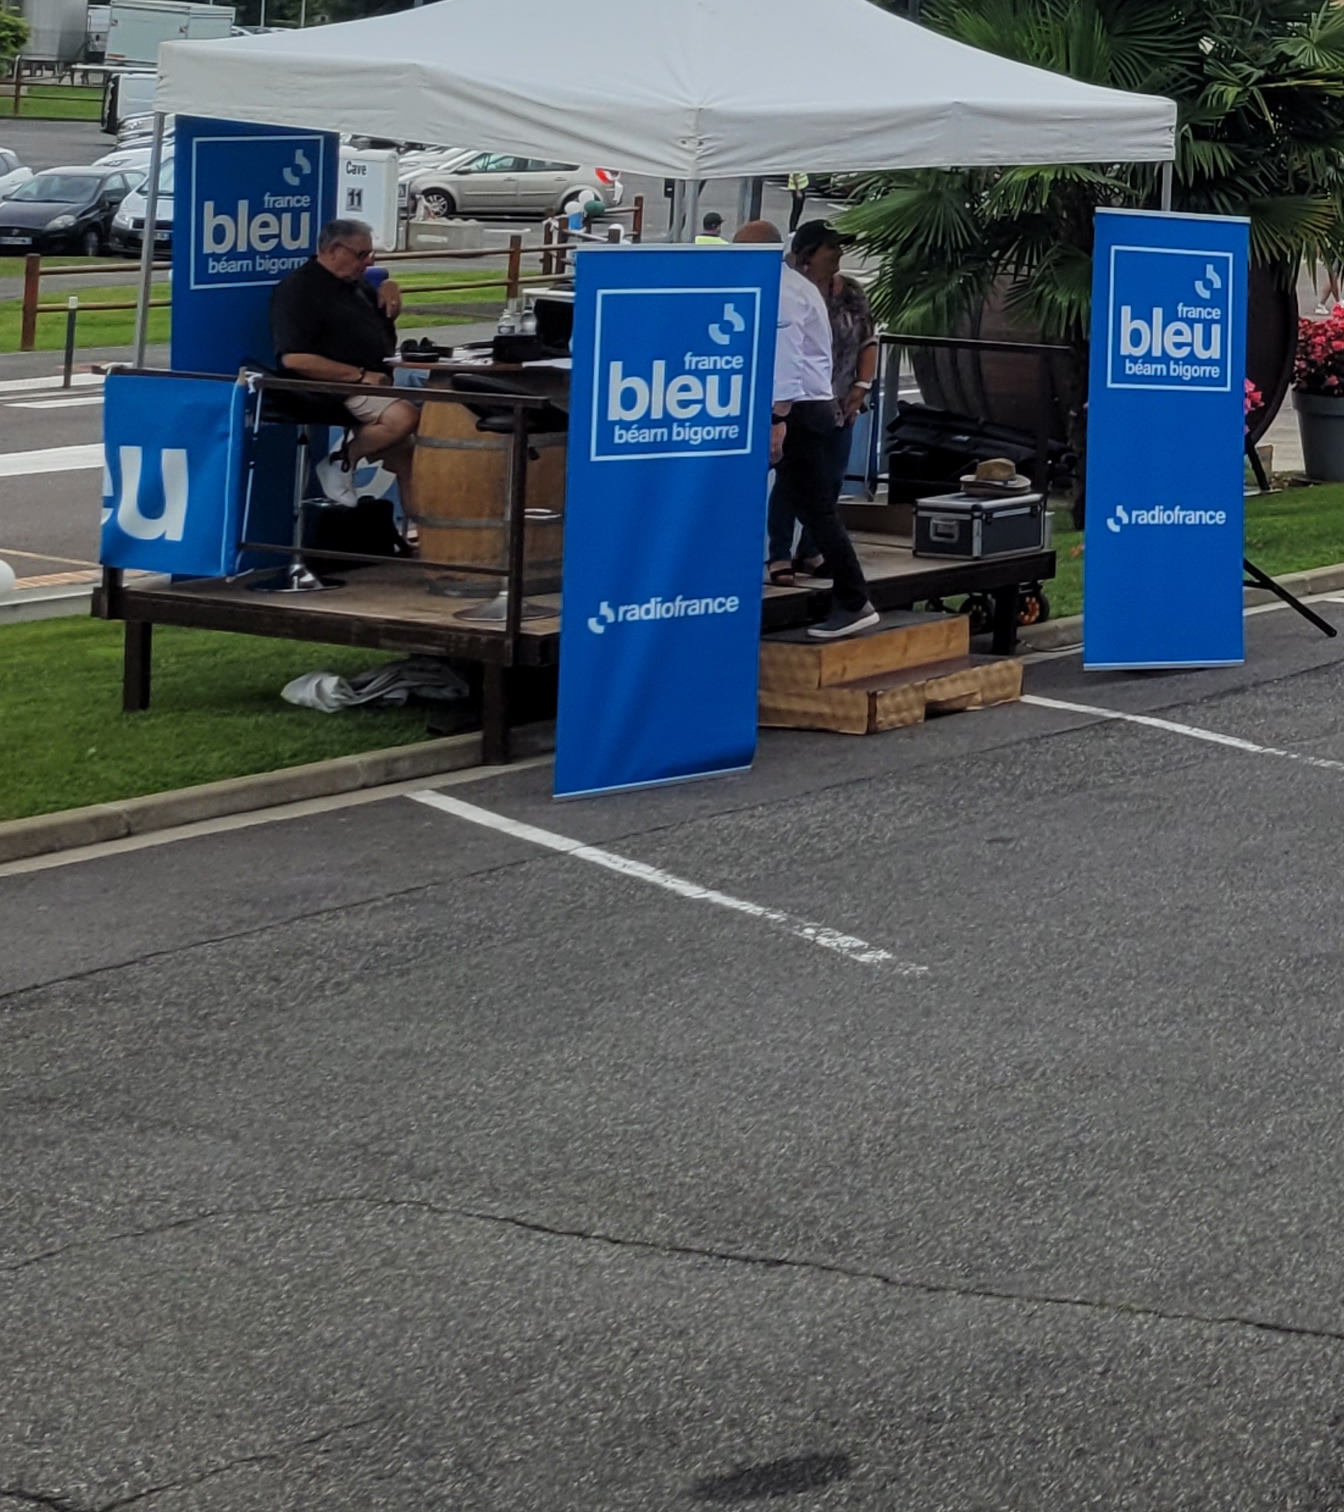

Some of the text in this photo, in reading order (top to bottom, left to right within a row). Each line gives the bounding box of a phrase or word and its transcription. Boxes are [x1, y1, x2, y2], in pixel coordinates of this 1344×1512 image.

[345, 160, 367, 176] Cave
[264, 192, 311, 209] france
[348, 188, 362, 207] 11
[203, 199, 311, 254] bleu
[208, 256, 252, 274] béarn
[1177, 302, 1221, 319] france
[1120, 305, 1221, 359] bleu
[684, 352, 744, 370] france
[1125, 359, 1220, 380] béarn bigorre
[607, 360, 743, 421] bleu
[613, 422, 739, 444] béarn bigorre
[1131, 505, 1226, 525] radiofrance
[618, 595, 739, 622] radiofrance
